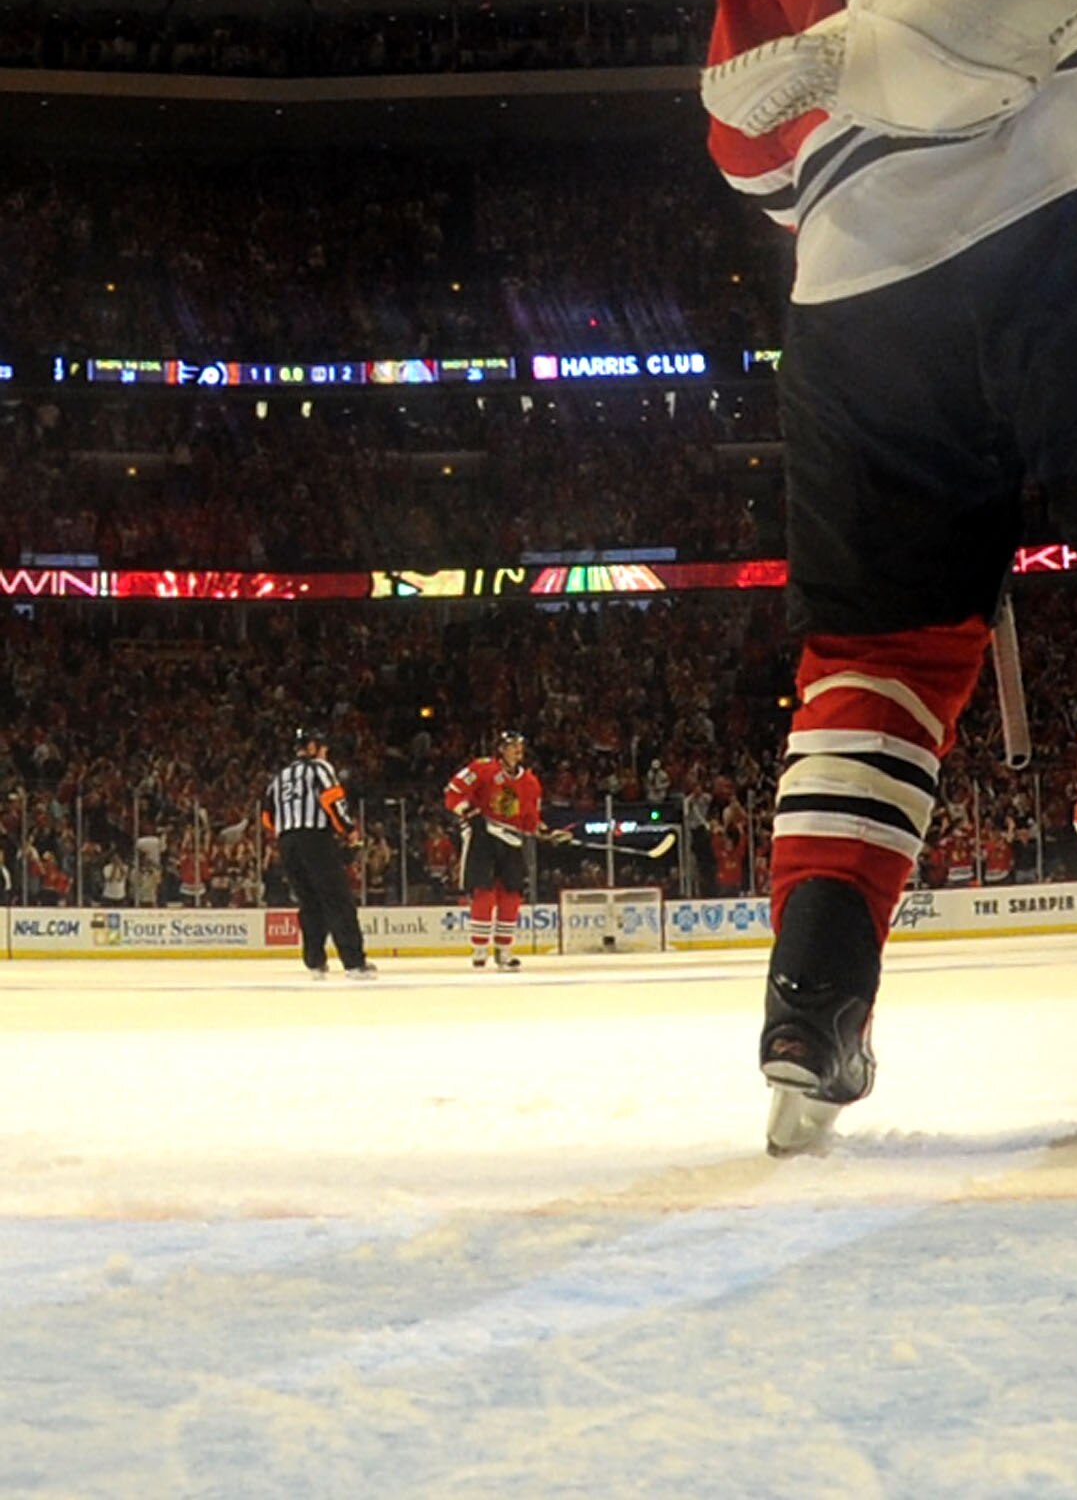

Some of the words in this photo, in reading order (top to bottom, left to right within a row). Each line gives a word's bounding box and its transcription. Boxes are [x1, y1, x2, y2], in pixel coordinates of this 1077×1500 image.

[560, 355, 639, 377] HARRIS
[646, 353, 706, 374] CLUB
[973, 899, 999, 916] THE
[1008, 895, 1075, 915] SHARPER
[13, 920, 80, 937] NHL.COM
[123, 918, 166, 938] Four
[170, 918, 248, 938] Seasons
[268, 915, 298, 938] mb
[382, 915, 428, 936] bank
